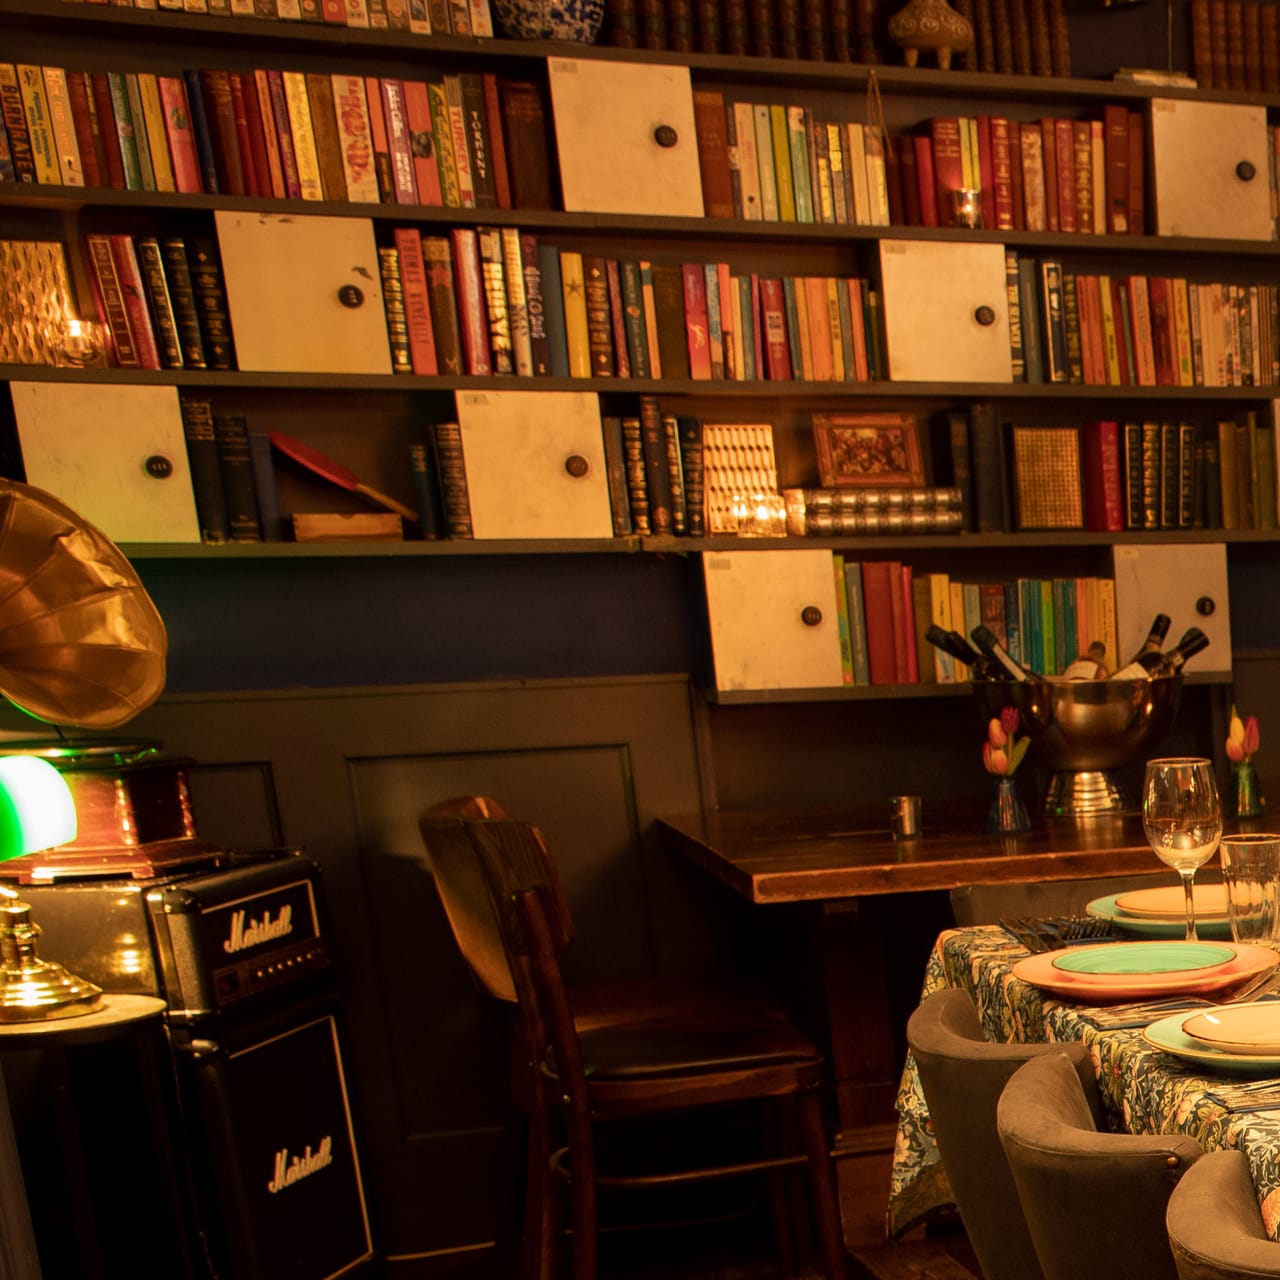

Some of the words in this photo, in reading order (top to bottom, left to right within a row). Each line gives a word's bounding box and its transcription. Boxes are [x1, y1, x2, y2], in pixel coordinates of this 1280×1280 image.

[1, 84, 27, 130] BURN
[11, 130, 32, 169] RATE
[450, 109, 469, 176] TURKEY
[223, 903, 293, 954] Marshall
[267, 1135, 333, 1194] Marshall
